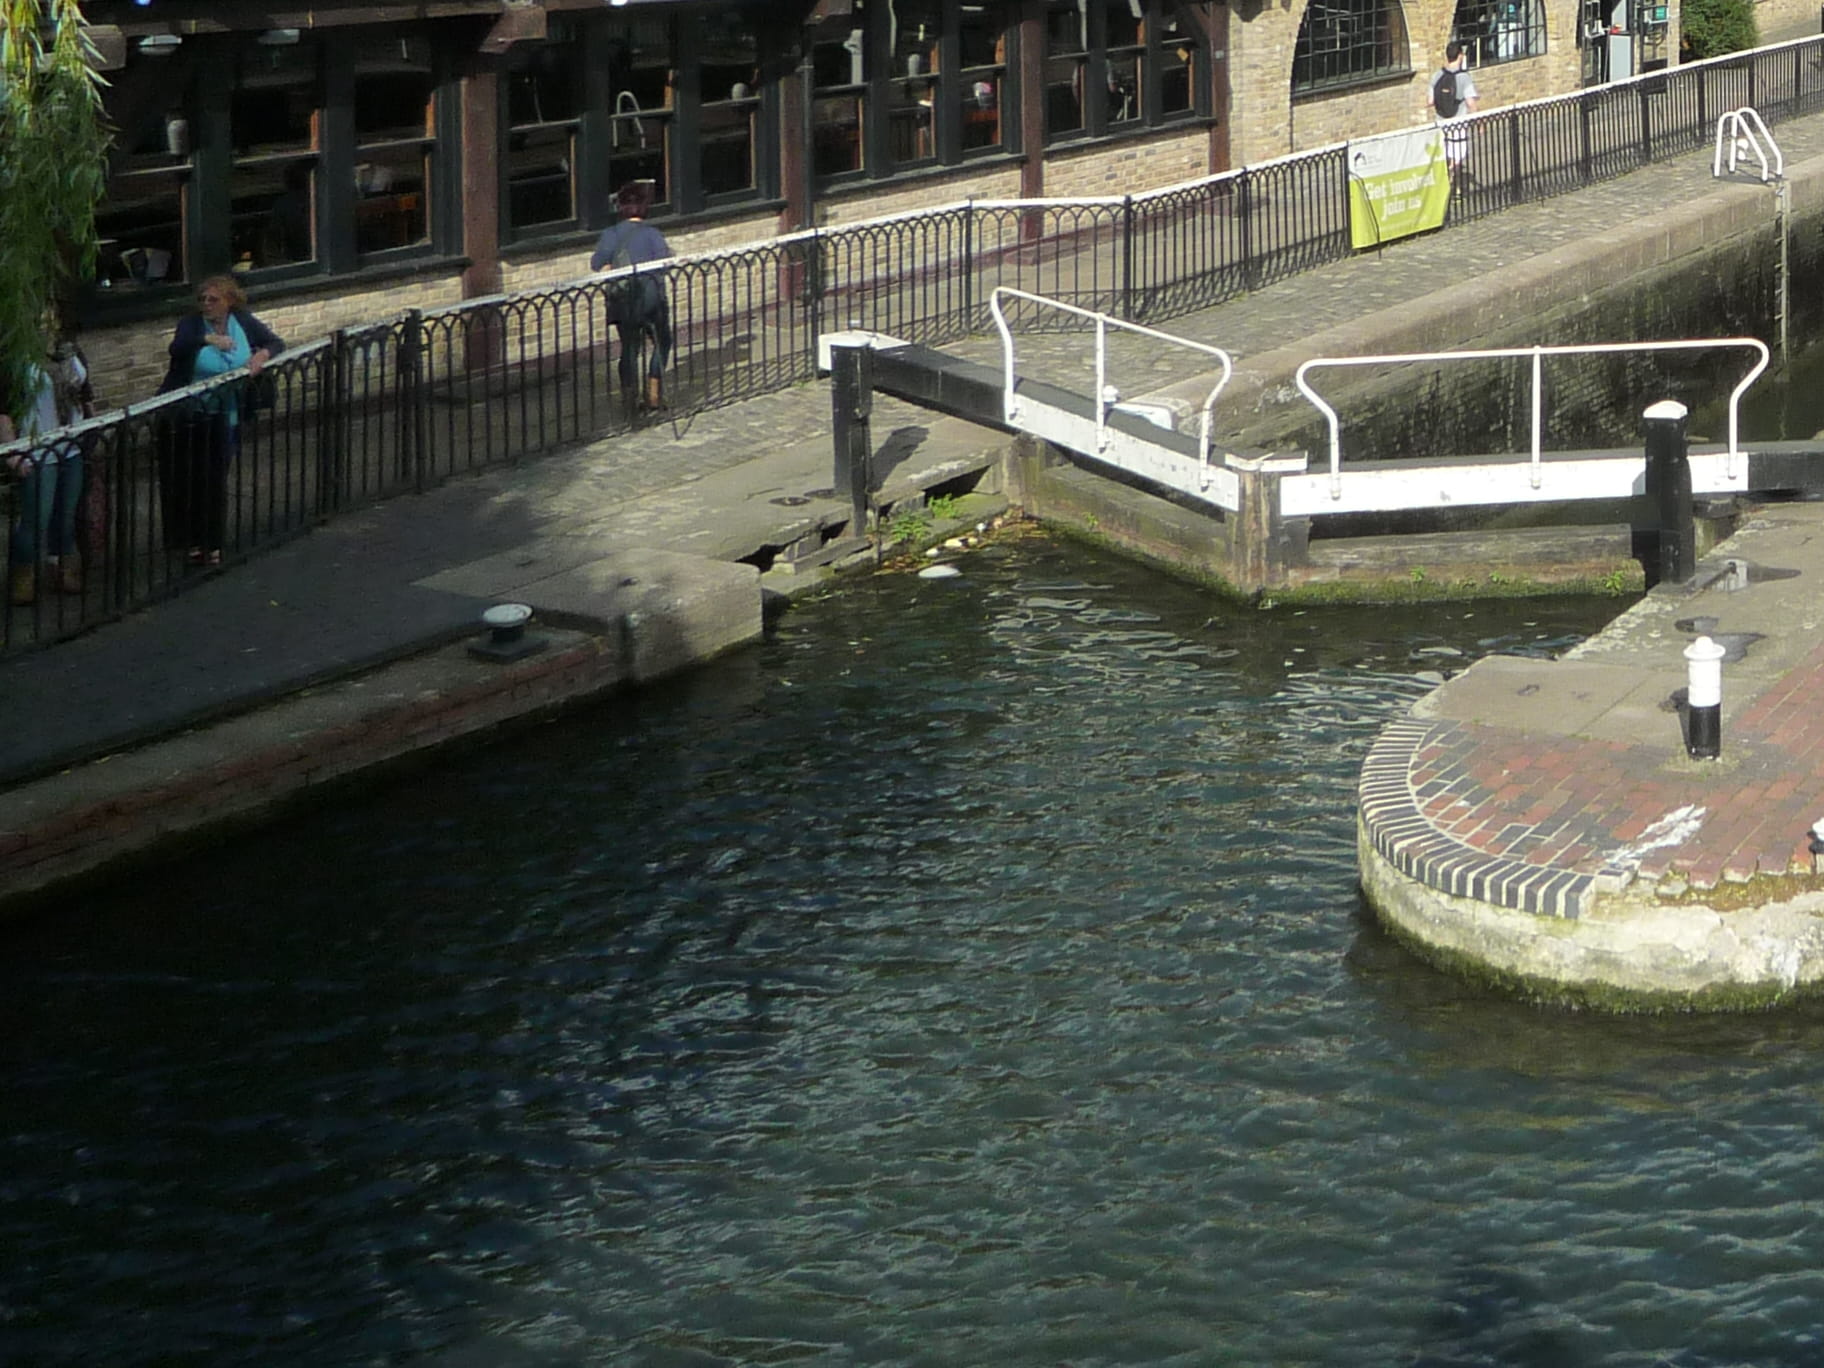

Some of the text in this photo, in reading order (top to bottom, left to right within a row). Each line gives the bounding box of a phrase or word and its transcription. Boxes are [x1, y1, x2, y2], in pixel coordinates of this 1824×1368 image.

[1365, 181, 1387, 201] Get
[1382, 195, 1422, 223] join us
